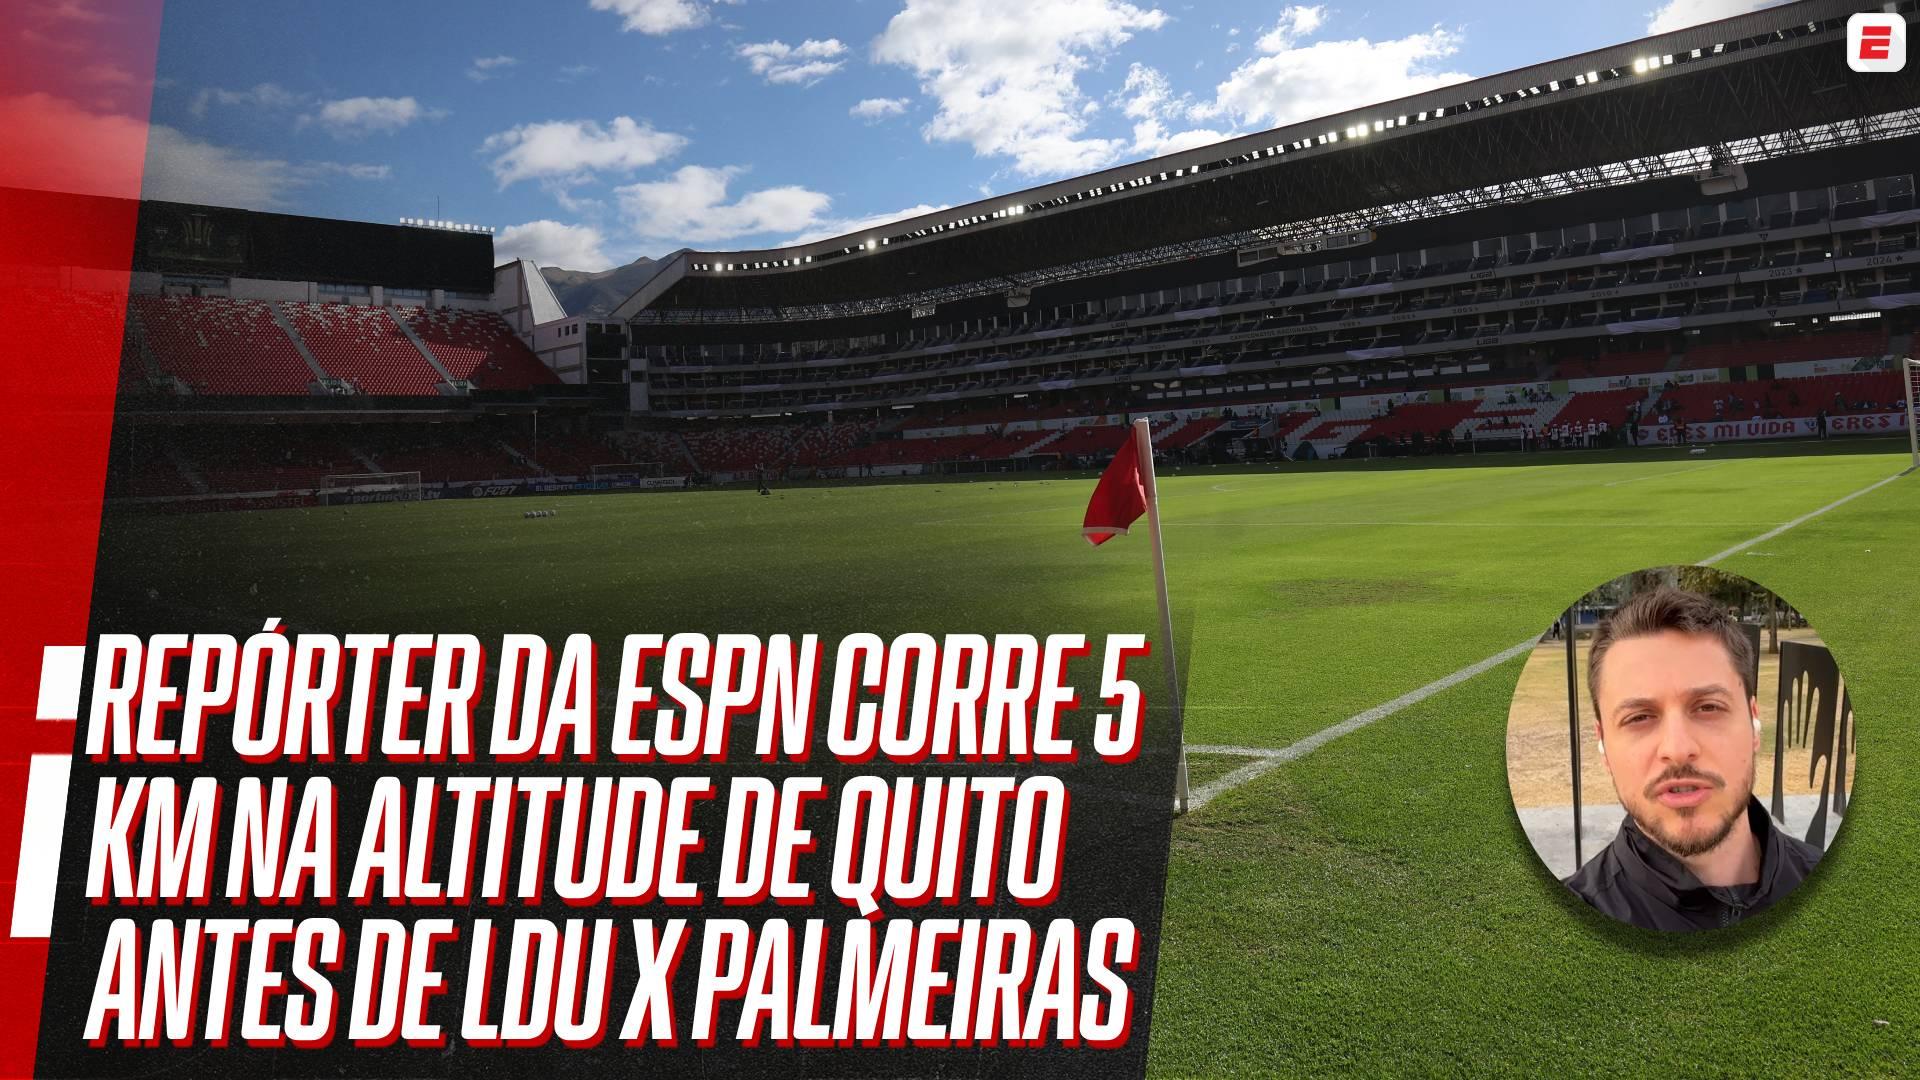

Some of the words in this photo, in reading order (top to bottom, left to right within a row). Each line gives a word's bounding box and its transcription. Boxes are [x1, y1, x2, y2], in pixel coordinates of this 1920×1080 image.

[1865, 256, 1893, 267] 2024
[1768, 267, 1794, 278] 2023
[1832, 414, 1890, 431] ERES
[1713, 423, 1741, 438] MI
